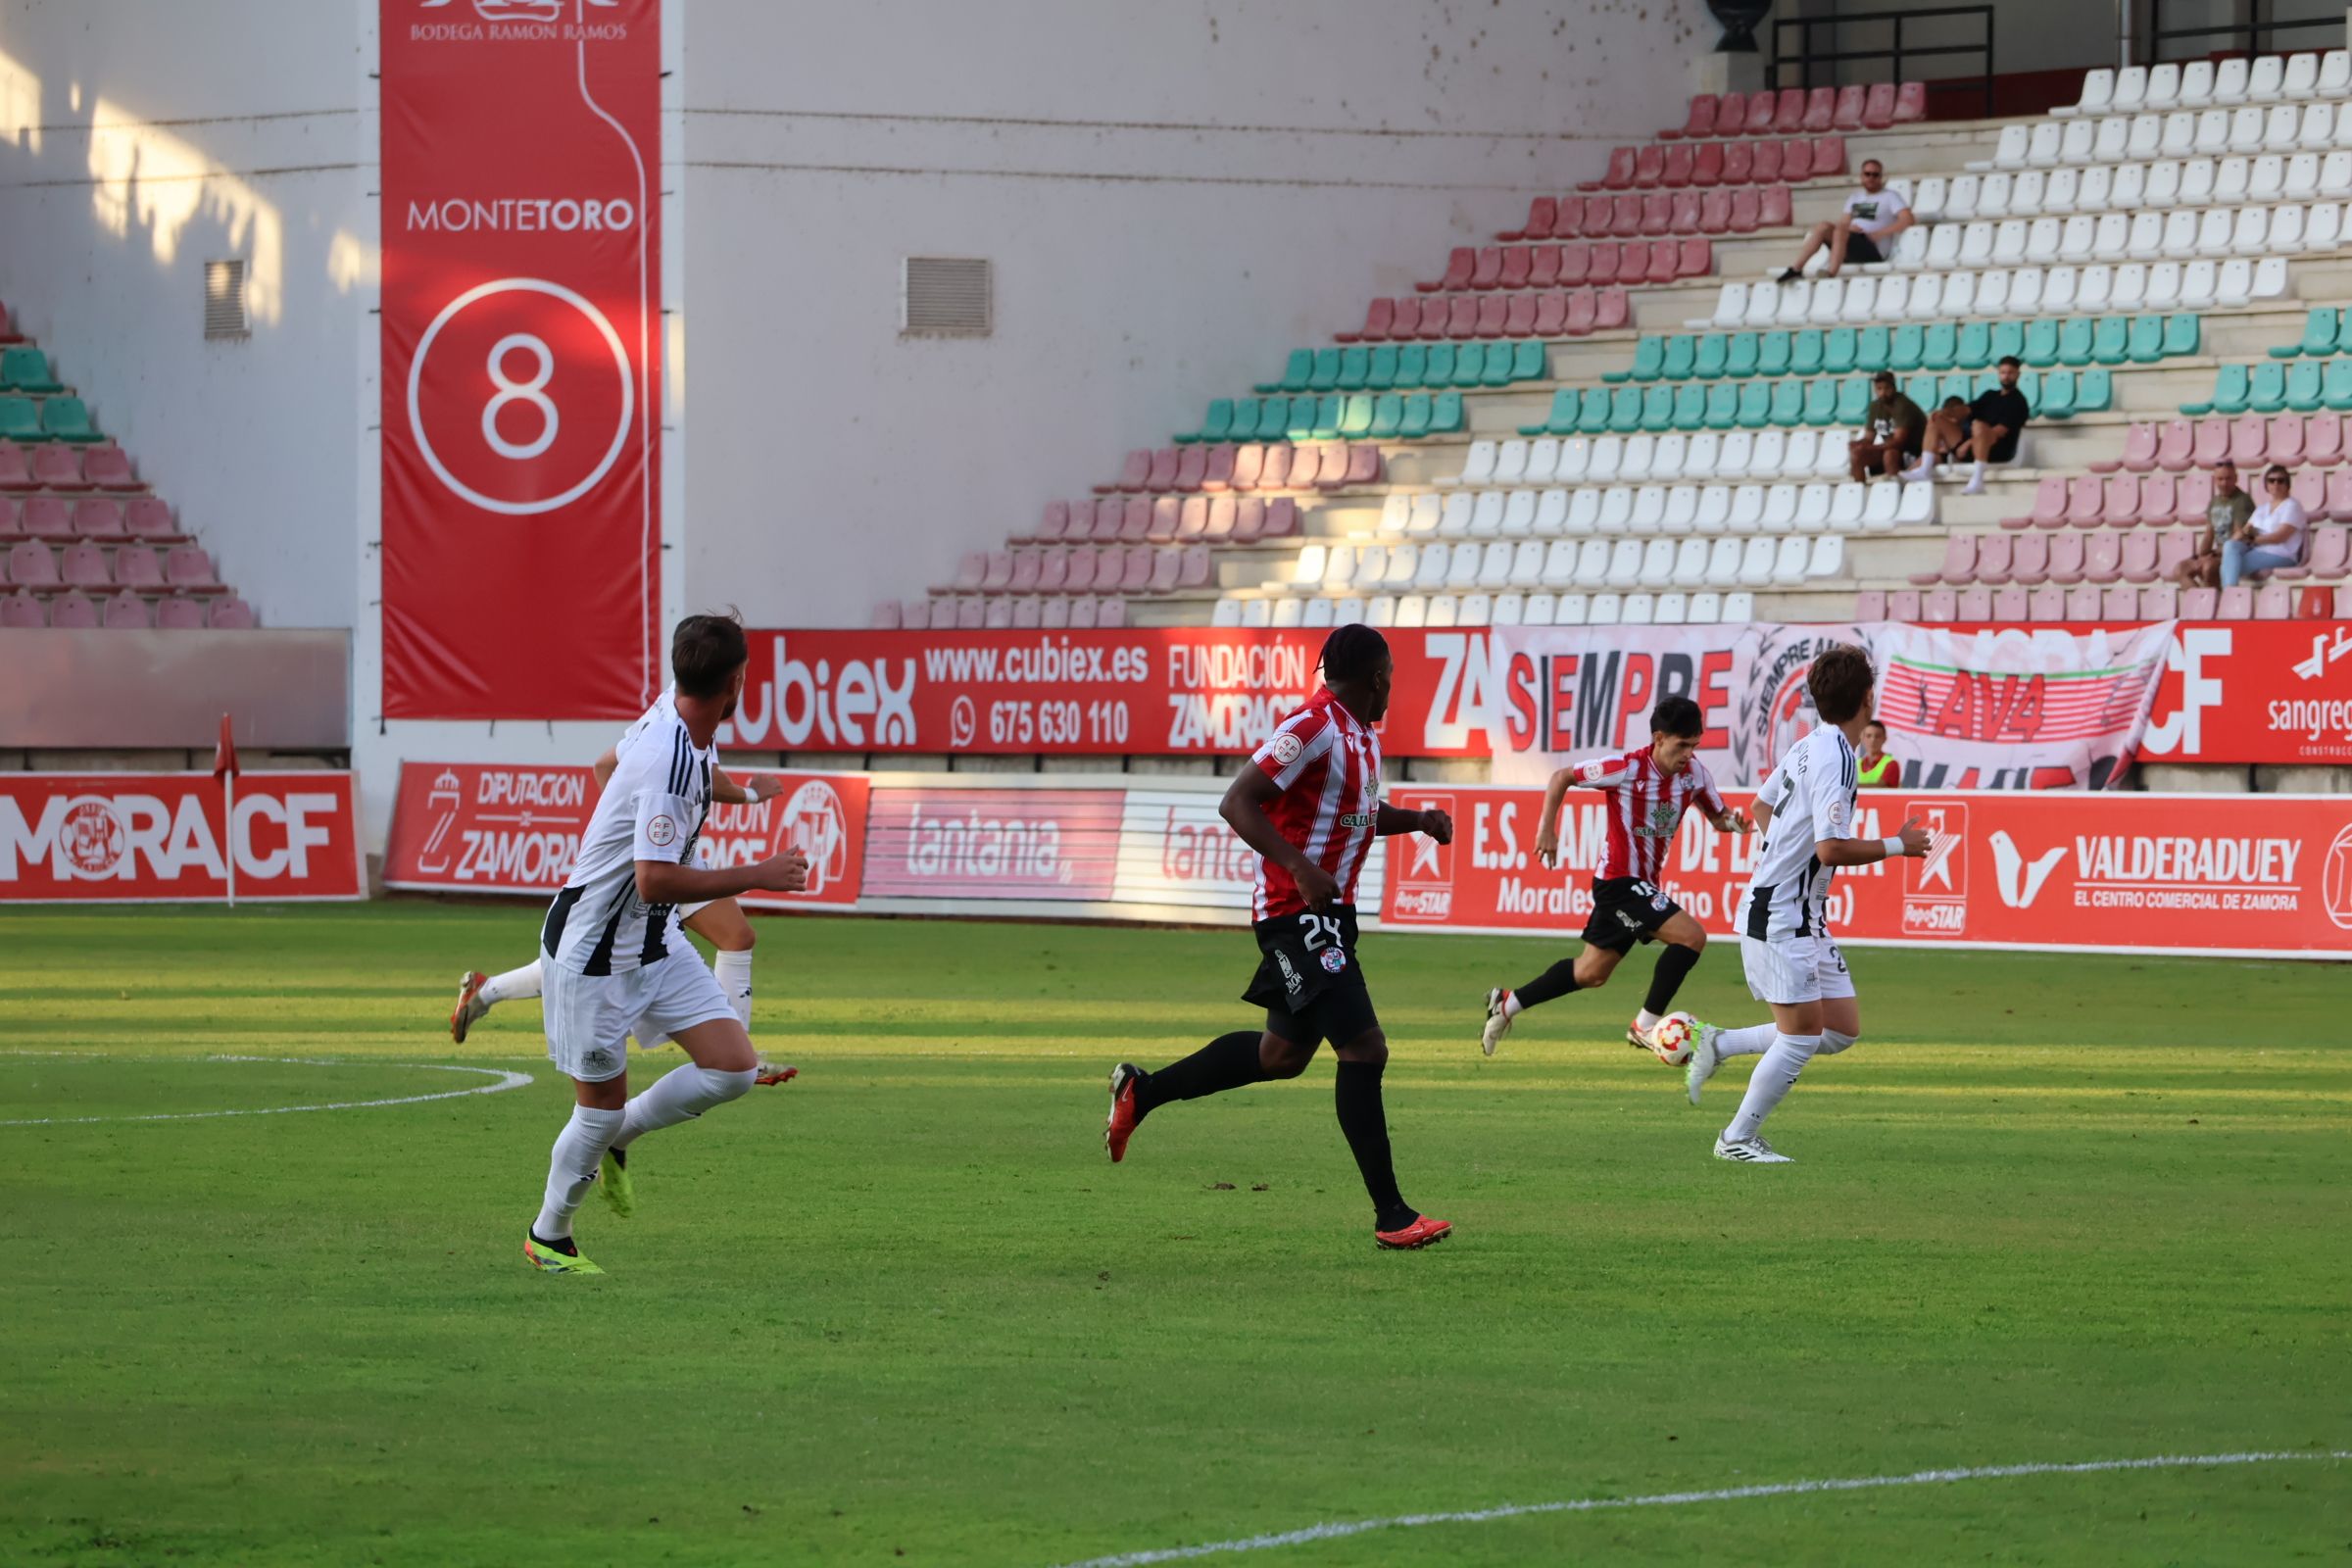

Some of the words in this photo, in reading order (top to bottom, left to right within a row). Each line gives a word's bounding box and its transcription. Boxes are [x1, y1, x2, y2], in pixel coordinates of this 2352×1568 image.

[411, 24, 483, 40] BODEGA
[489, 24, 557, 39] RAMON
[564, 24, 627, 39] RAMOS
[407, 199, 634, 231] MONTETORO
[481, 332, 559, 460] 8
[925, 636, 1149, 683] www.cubiex.es
[1168, 636, 1306, 689] FUNDACIÓN
[719, 636, 917, 746] ubiex
[1506, 649, 1734, 752] SIEMPRE
[990, 701, 1034, 744] 675
[1039, 701, 1081, 744] 630
[1088, 701, 1129, 744] 110
[454, 830, 580, 883] ZAMORA
[906, 802, 1061, 876] lantania
[1162, 805, 1255, 882] lanta
[1472, 801, 1527, 870] E.S.
[1680, 805, 1721, 873] DE
[2076, 836, 2301, 883] VALDERADUEY
[2075, 891, 2090, 906] EL
[2092, 891, 2143, 908] CENTRO
[2146, 893, 2220, 909] COMERCIAL
[2223, 894, 2239, 909] DE
[2242, 894, 2298, 910] ZAMORA
[1298, 913, 1344, 952] 24
